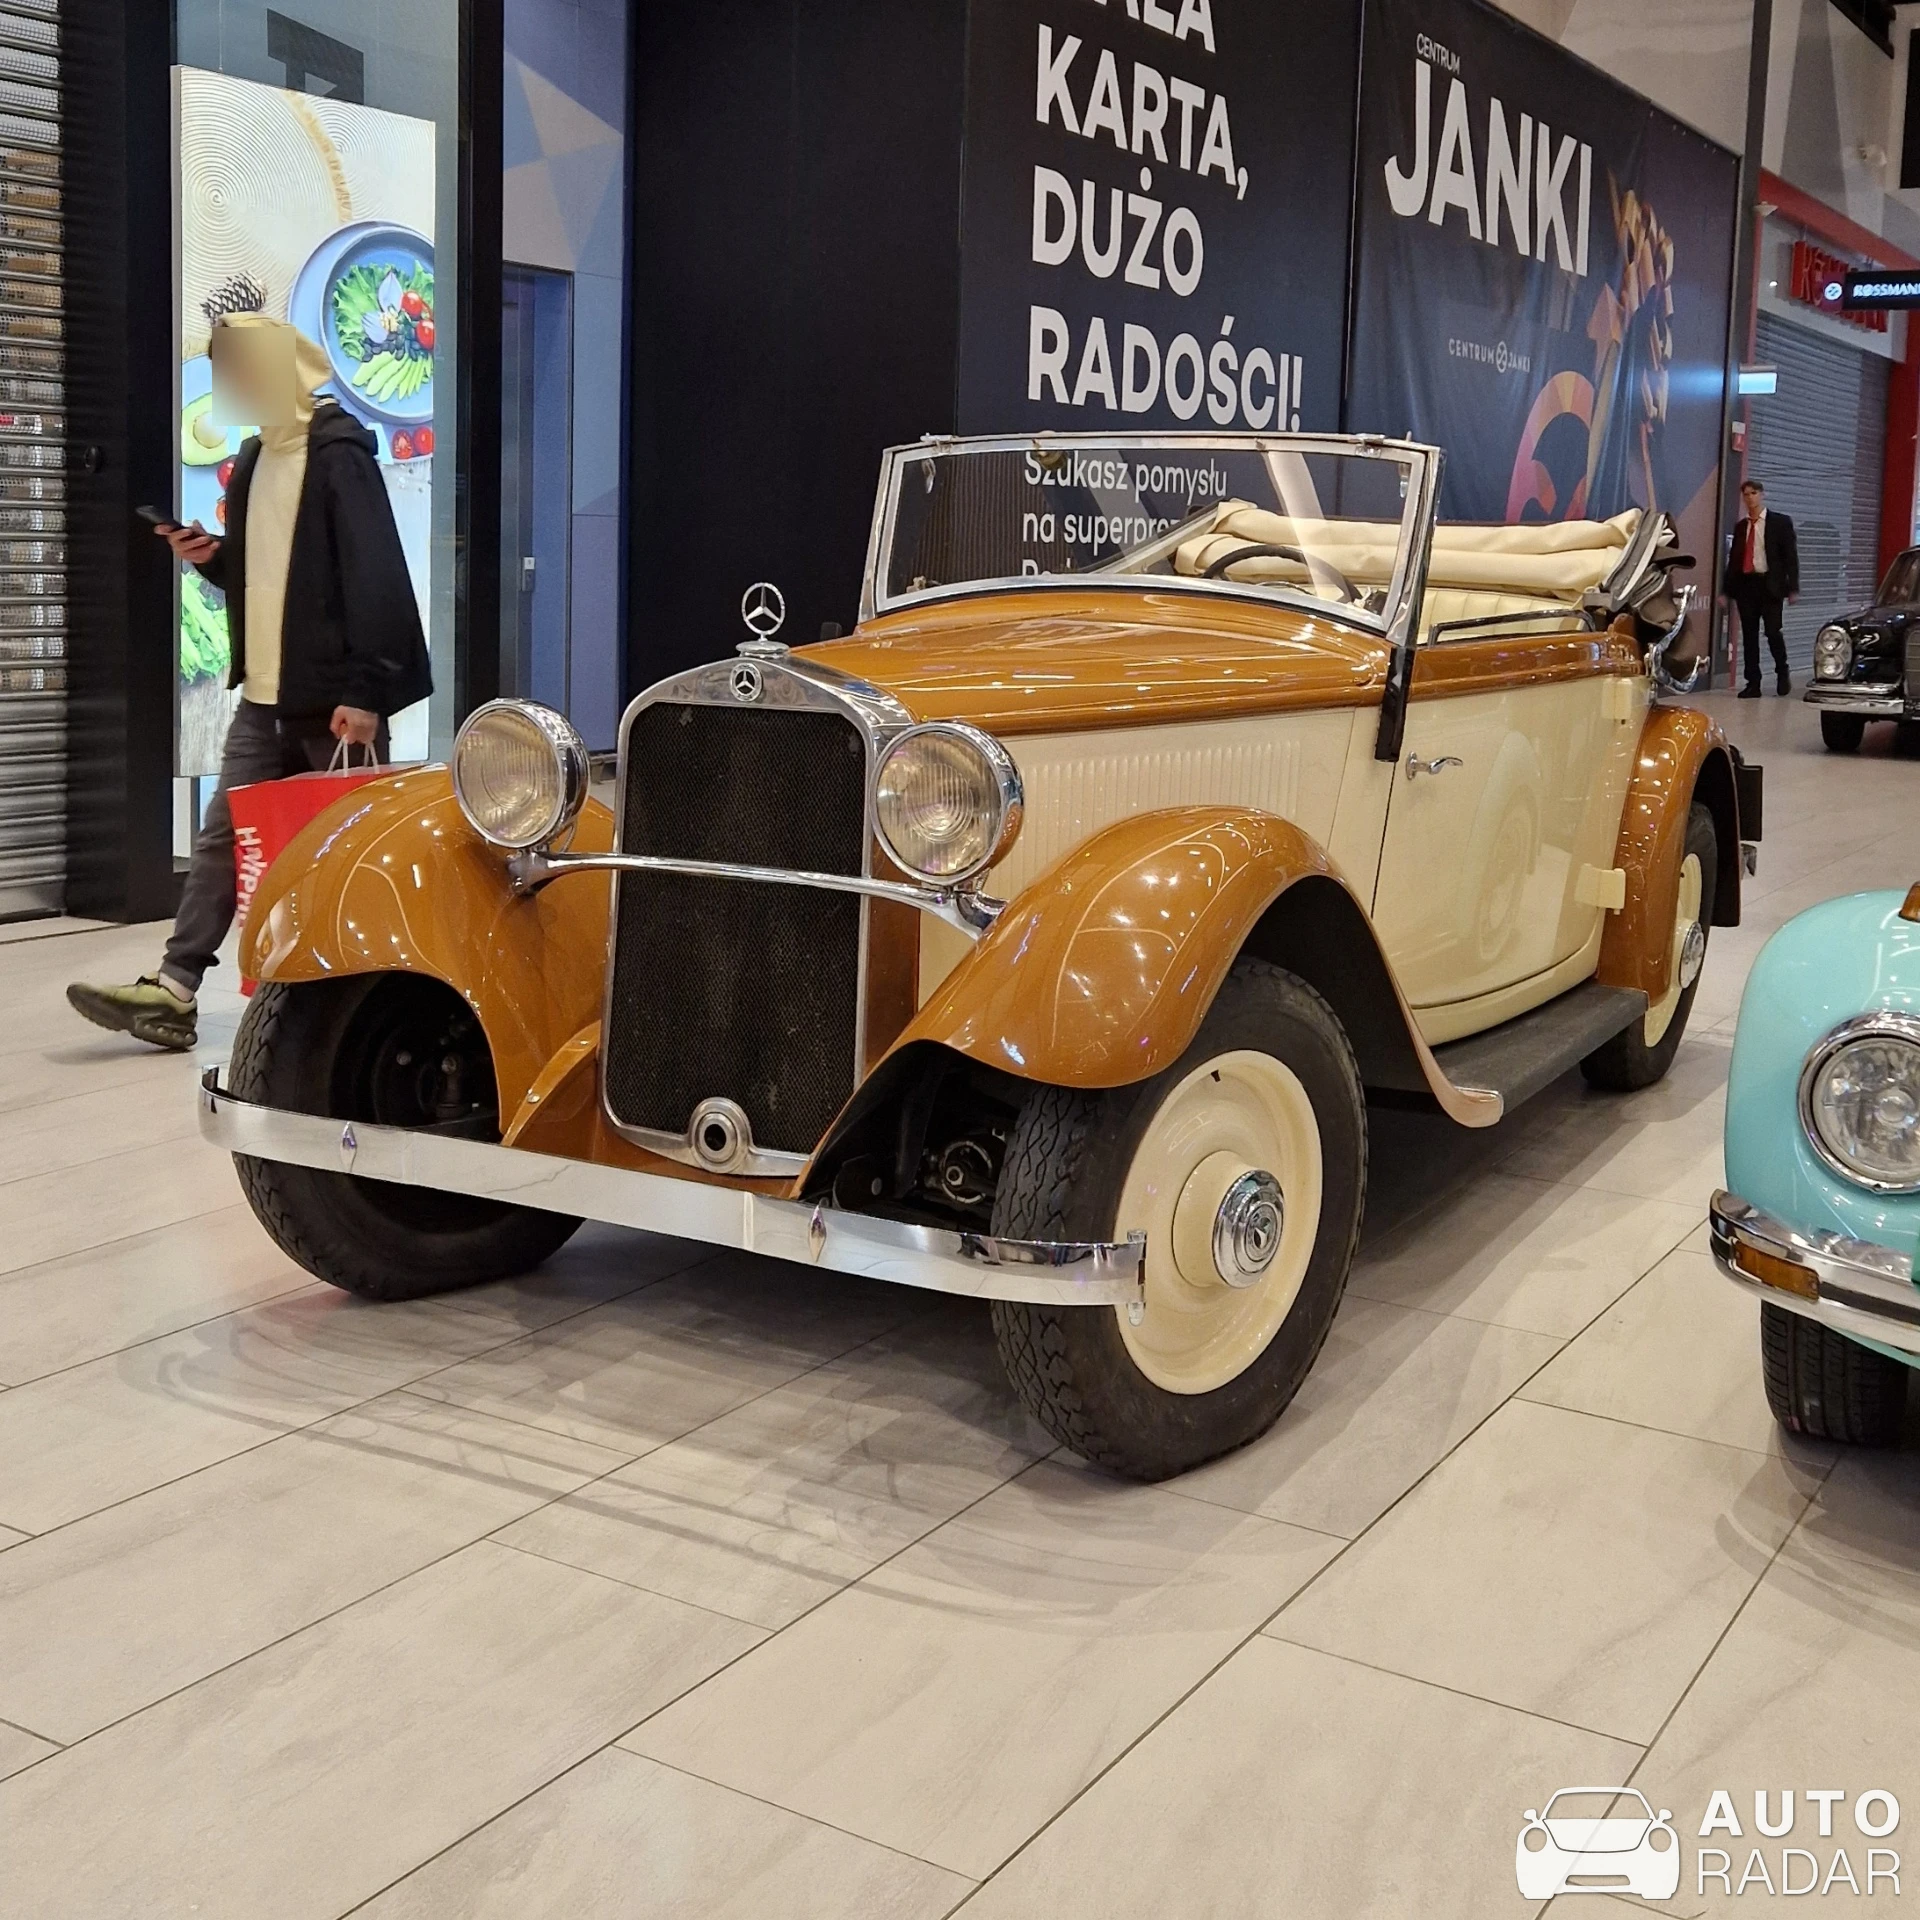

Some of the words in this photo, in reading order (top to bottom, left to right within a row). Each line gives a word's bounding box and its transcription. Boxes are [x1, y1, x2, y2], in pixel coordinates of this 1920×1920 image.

[1416, 32, 1461, 75] CENTRUM
[1036, 23, 1248, 200] KARTA,
[1384, 59, 1592, 277] JANKI
[1032, 166, 1204, 297] DUŻO
[1027, 305, 1303, 434] RADOŚCI!
[1448, 338, 1495, 364] CENTRUM
[1508, 351, 1531, 373] JANKI
[1024, 450, 1129, 490] Sukasz
[1135, 458, 1227, 506] pomysłu
[1023, 512, 1055, 543] na
